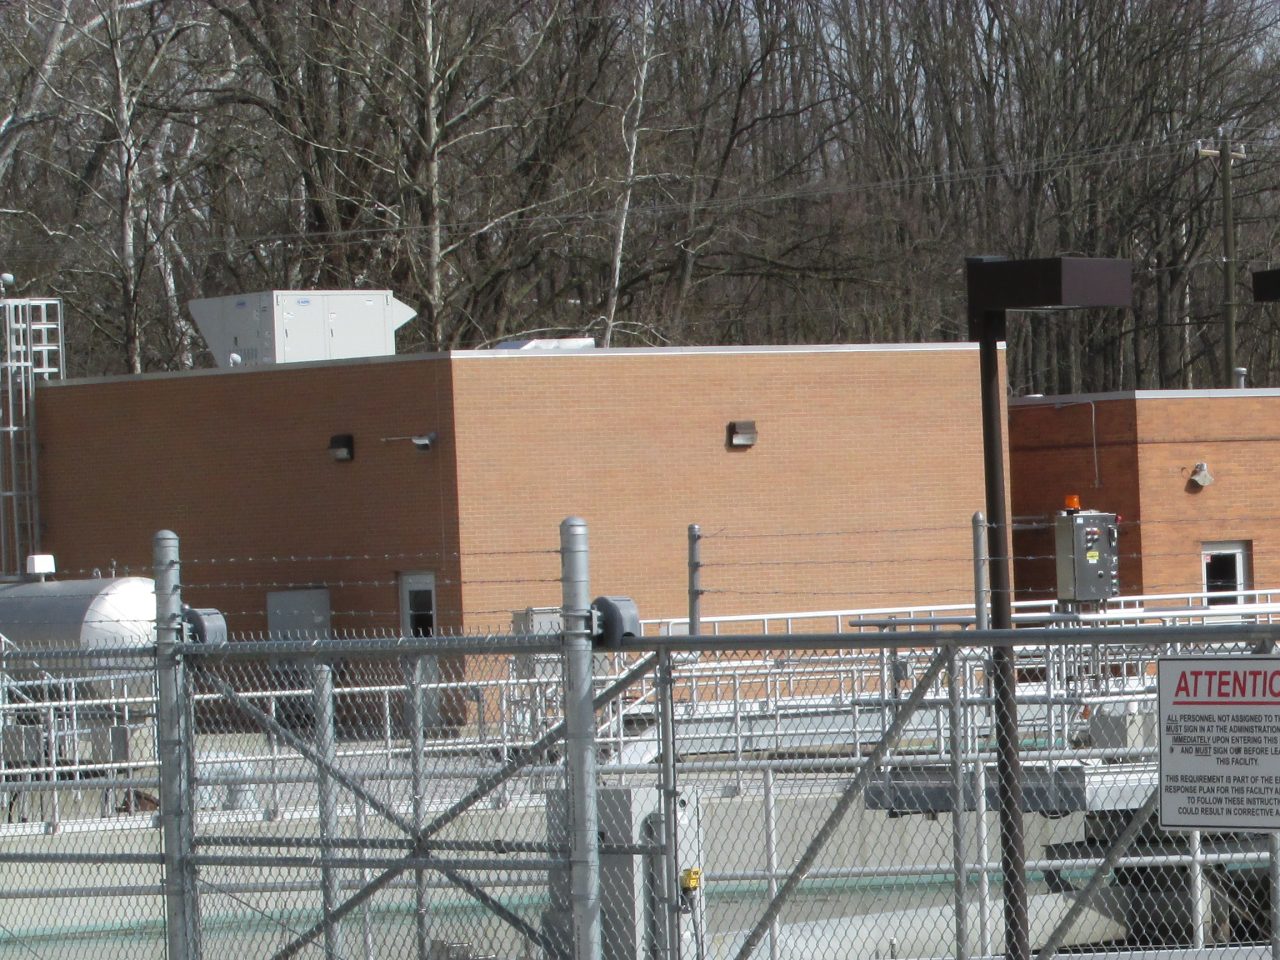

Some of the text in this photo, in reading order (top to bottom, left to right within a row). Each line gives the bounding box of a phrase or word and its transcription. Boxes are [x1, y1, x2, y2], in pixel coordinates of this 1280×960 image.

[1167, 715, 1178, 723] ALL
[1180, 715, 1215, 723] PERSONNEL
[1166, 725, 1182, 733] MUST
[1184, 725, 1198, 733] SIGN
[1229, 725, 1280, 733] ADMINISTRATION
[1172, 736, 1211, 744] IMMEDIATELY
[1212, 736, 1229, 744] UPON
[1231, 736, 1262, 744] ENTERING
[1264, 736, 1278, 744] THIS
[1181, 747, 1193, 755] AND
[1195, 747, 1211, 755] MUST
[1213, 747, 1228, 755] SIGN
[1244, 747, 1269, 755] BEFORE
[1166, 775, 1179, 783] THIS
[1180, 775, 1224, 783] REQUIREMENT
[1165, 786, 1197, 794] RESPONSE
[1199, 786, 1214, 794] PLAN
[1216, 786, 1229, 794] FOR
[1224, 797, 1244, 805] THESE
[1178, 807, 1199, 815] COULD
[1233, 808, 1273, 816] CORRECTIVE
